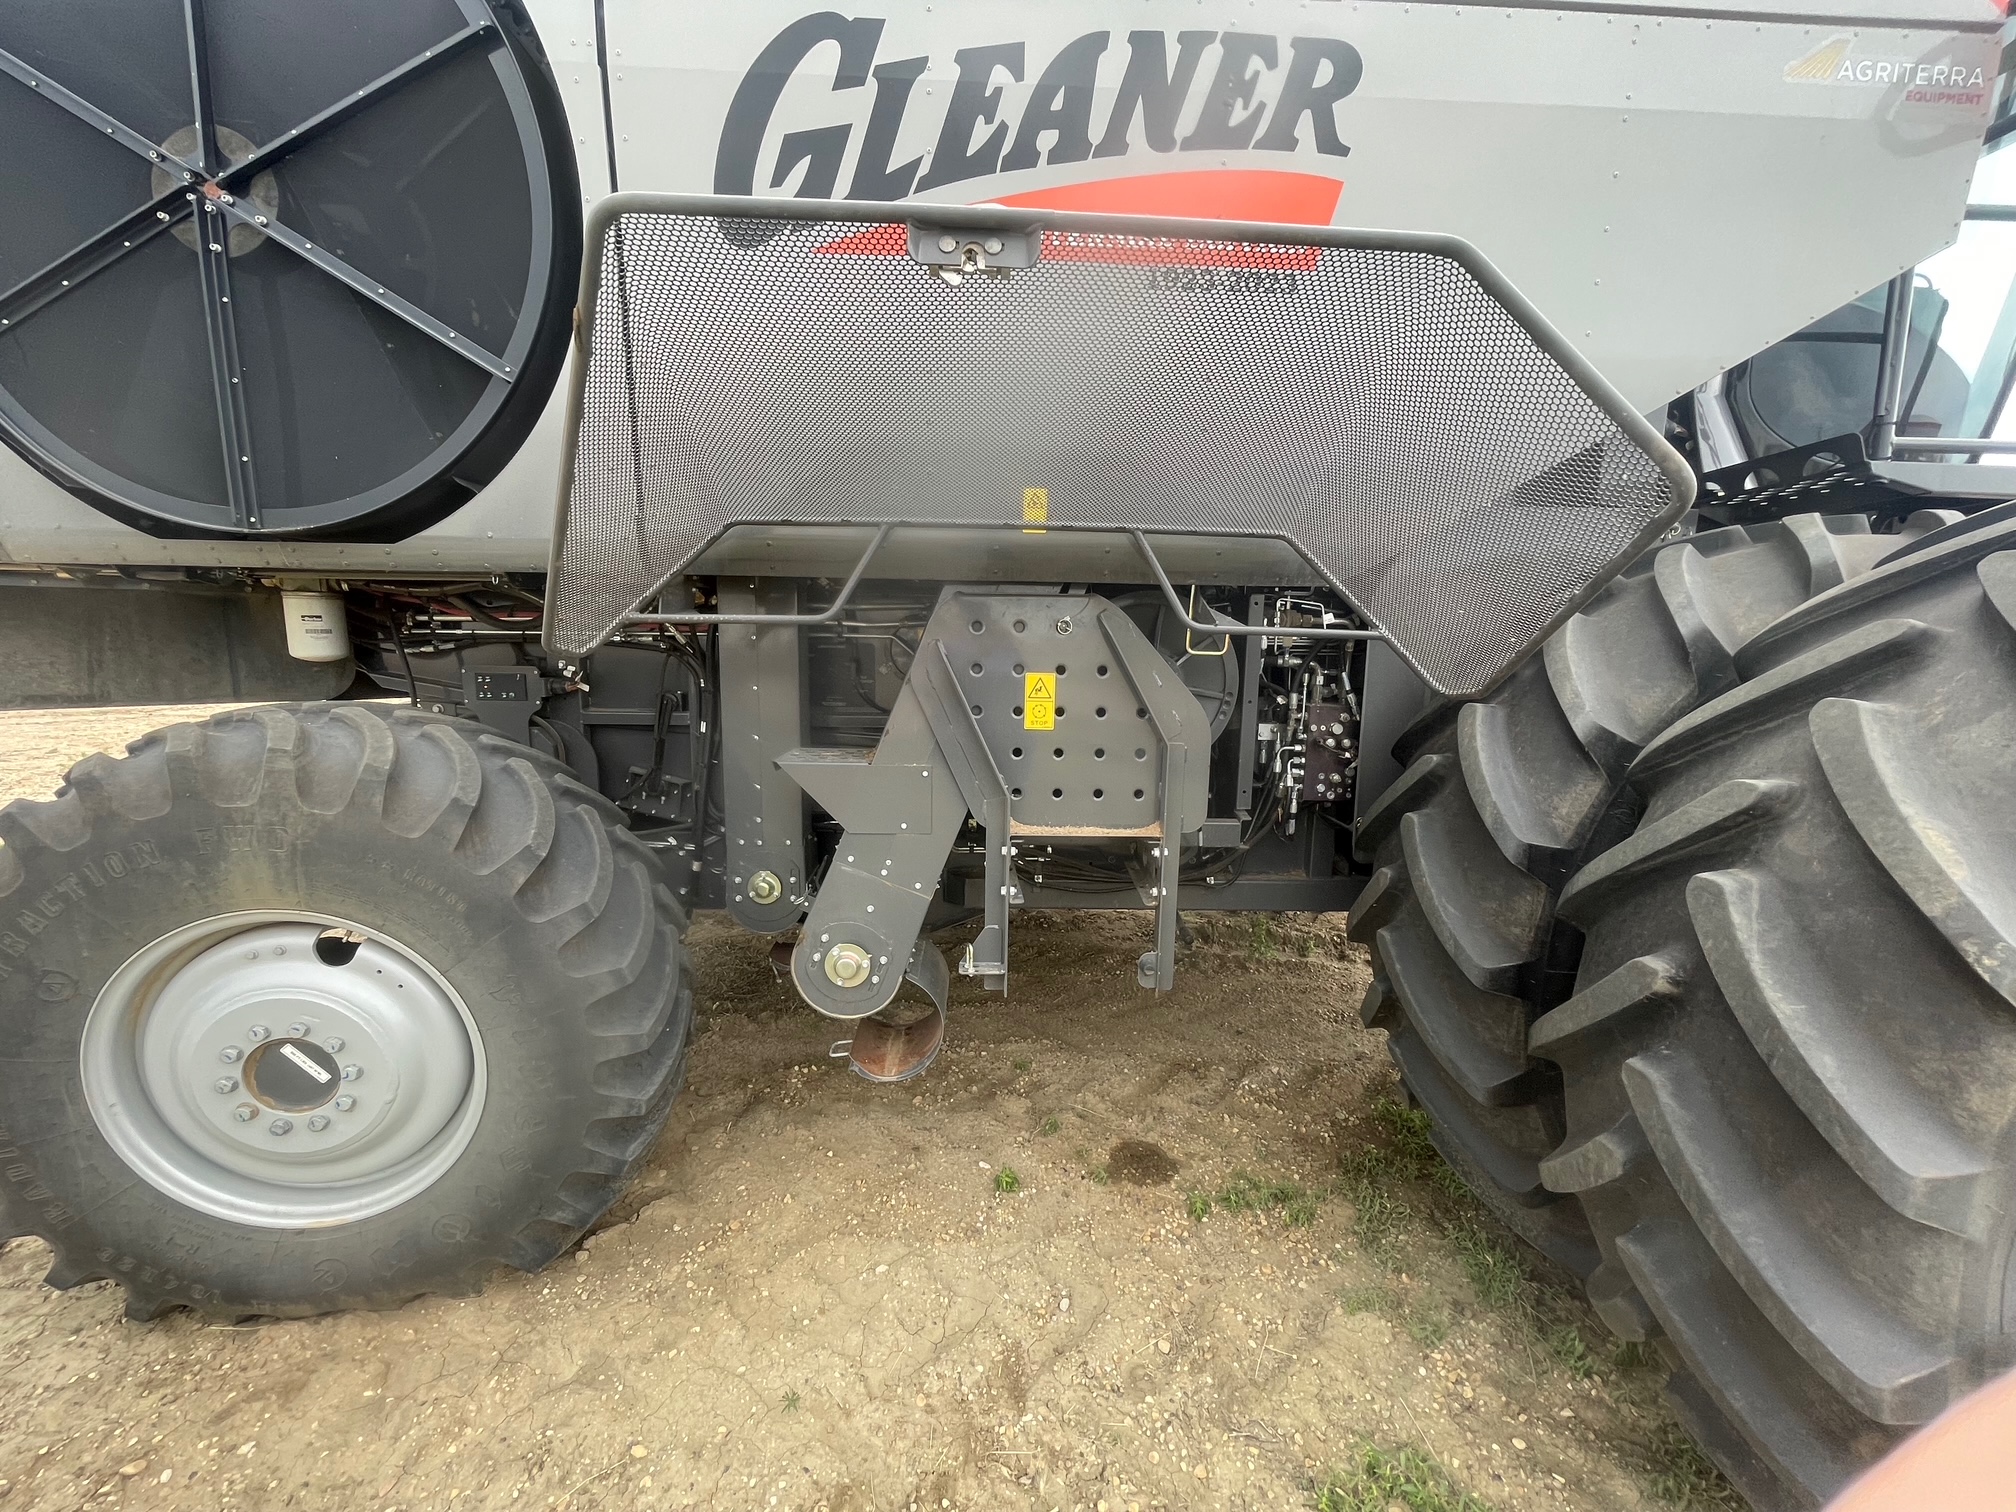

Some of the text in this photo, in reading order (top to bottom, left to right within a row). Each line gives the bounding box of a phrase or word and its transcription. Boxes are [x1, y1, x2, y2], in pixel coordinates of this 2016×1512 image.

[1836, 59, 1985, 88] AGRITERRA
[713, 10, 1364, 202] GLEANER
[1904, 90, 1985, 106] EQUIPMENT
